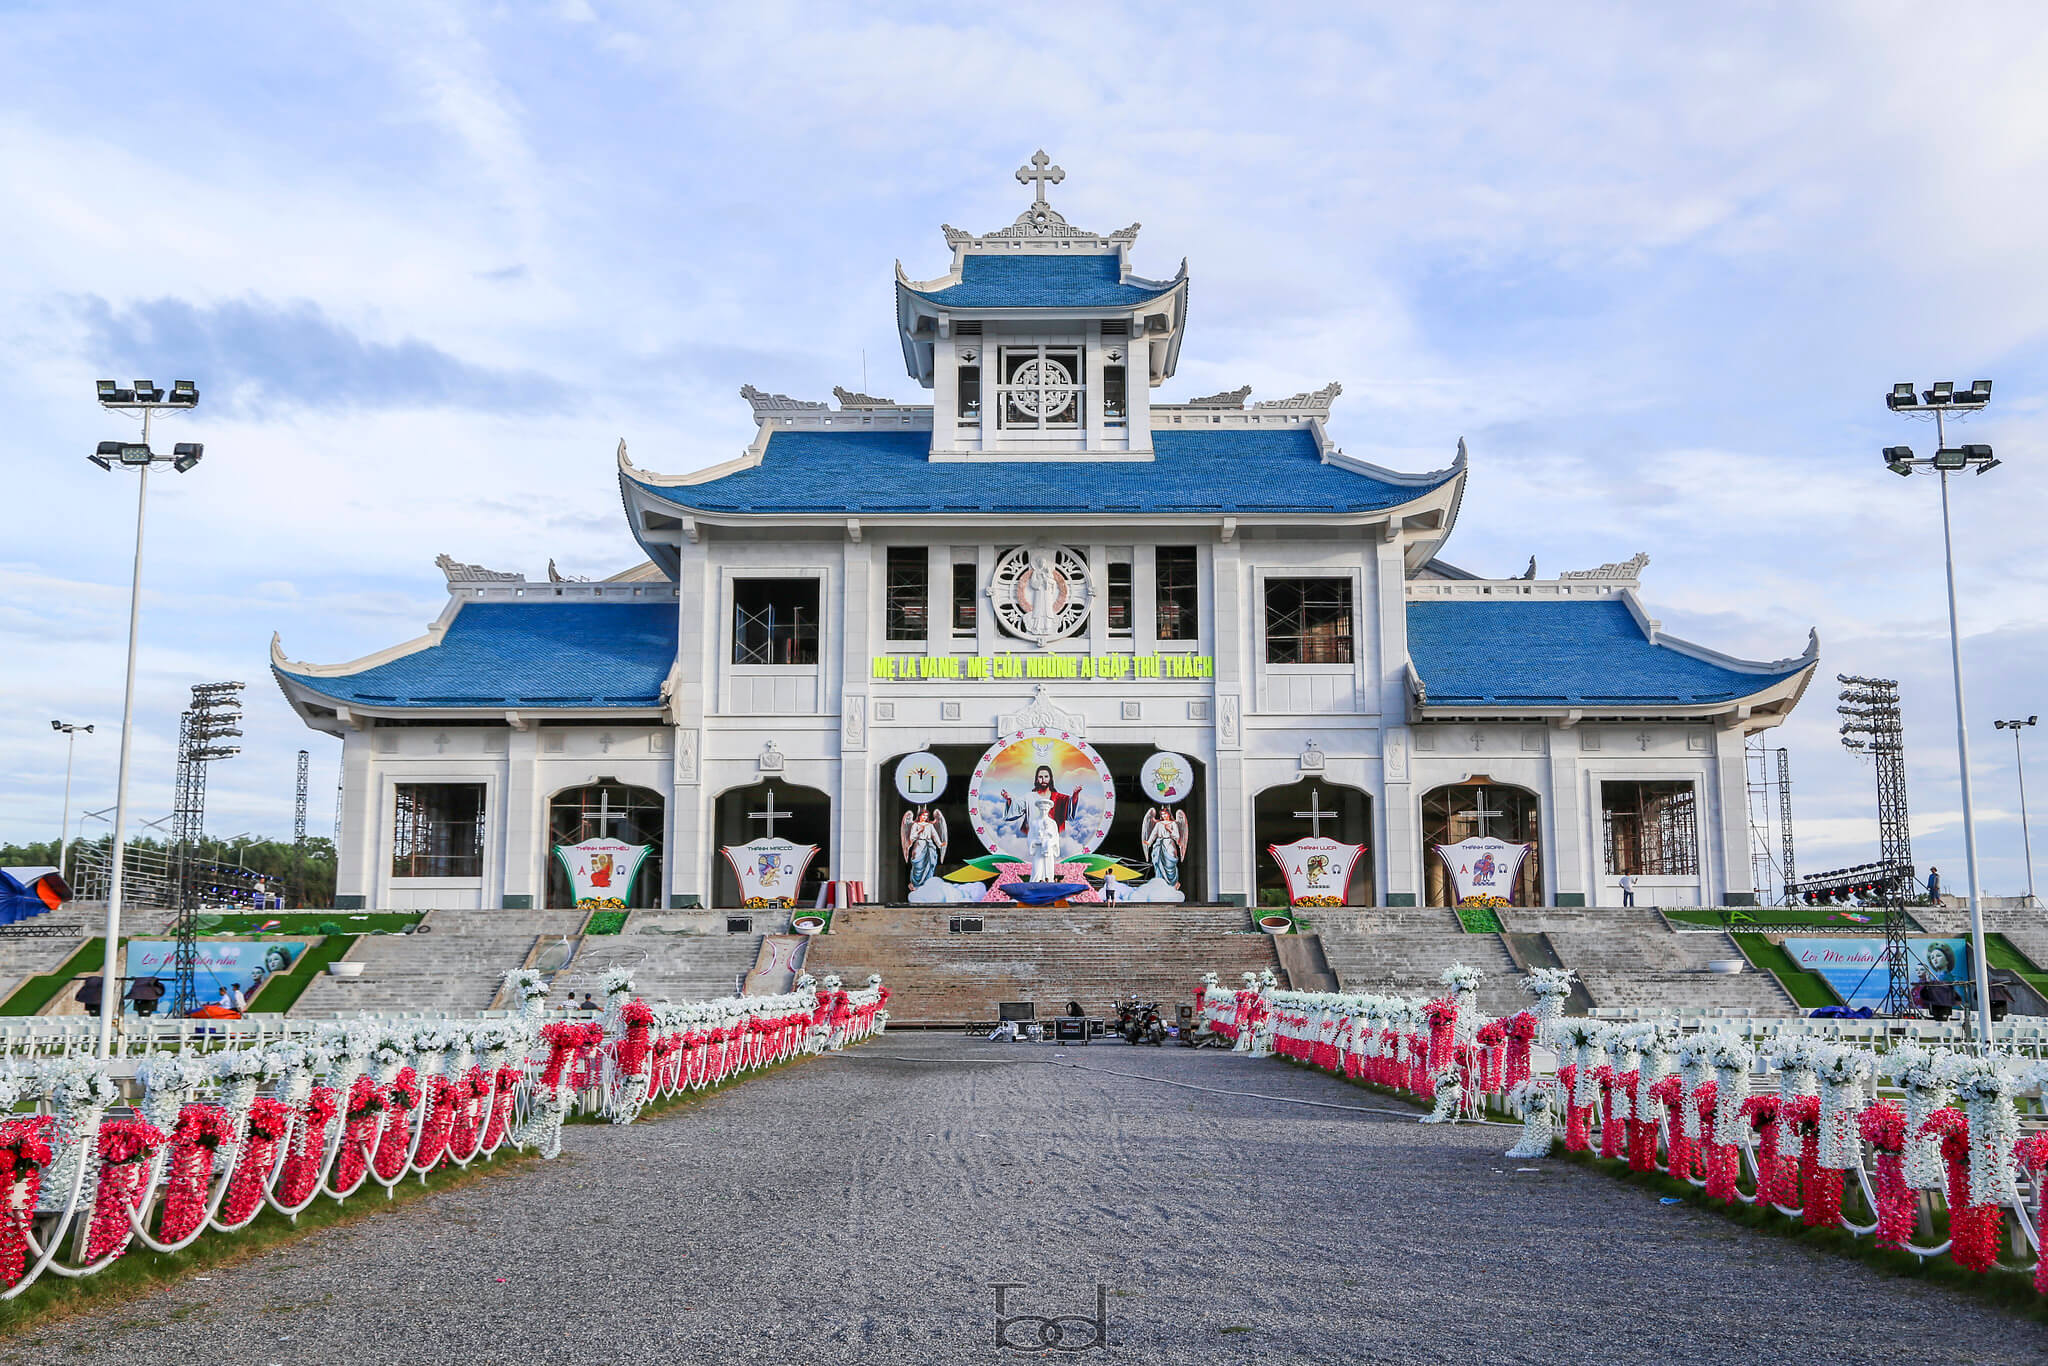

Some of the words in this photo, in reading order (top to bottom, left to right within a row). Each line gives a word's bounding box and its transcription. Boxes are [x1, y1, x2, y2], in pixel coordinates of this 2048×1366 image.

[873, 656, 896, 682] MẸ
[899, 656, 917, 678] LA
[967, 656, 990, 681] MẸ
[993, 650, 1023, 678] CỦA
[1081, 656, 1096, 678] AI
[1098, 652, 1130, 681] GẶP
[1132, 649, 1161, 678] THỬ
[1165, 651, 1213, 678] THÁCH
